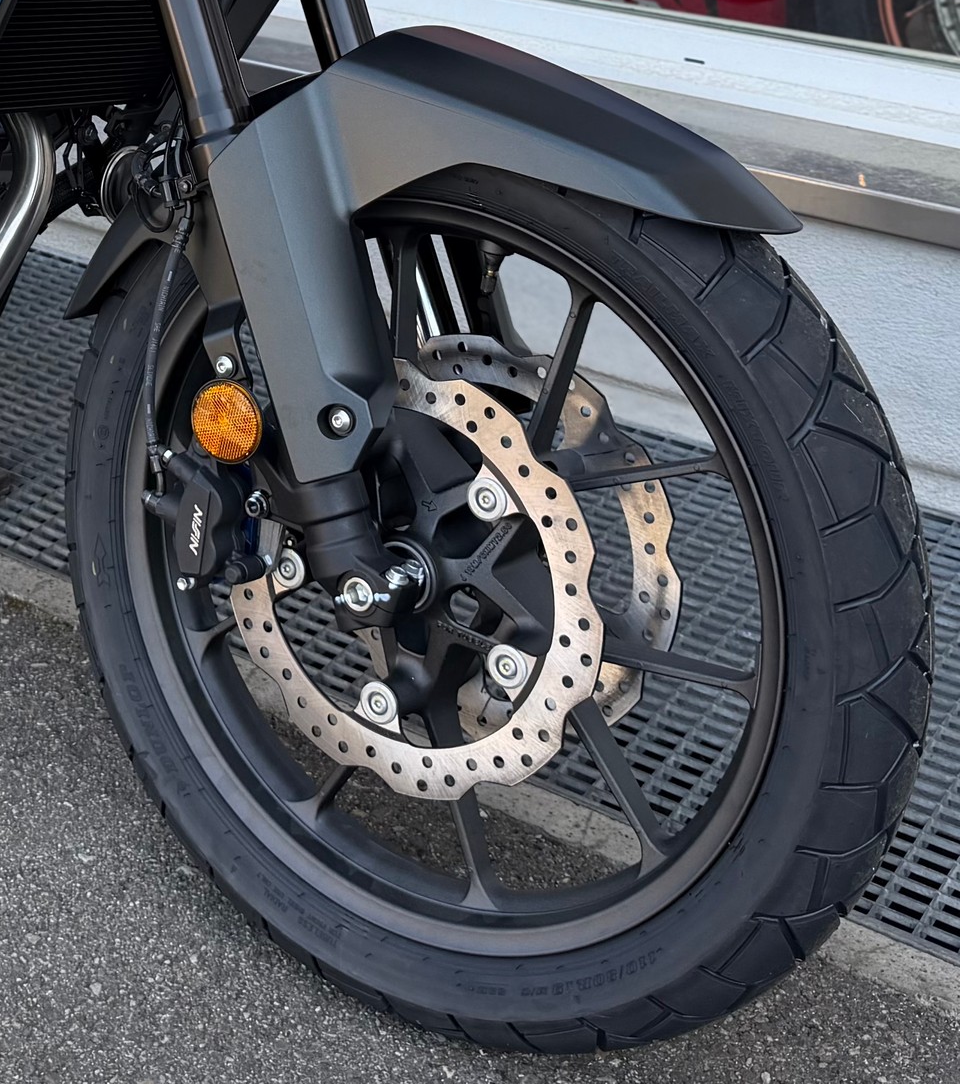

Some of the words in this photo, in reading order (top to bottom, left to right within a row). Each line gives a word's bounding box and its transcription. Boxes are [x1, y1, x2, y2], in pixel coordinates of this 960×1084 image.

[608, 248, 716, 360] TRAILMAX
[189, 504, 203, 556] NISSIN
[119, 664, 178, 774] DUNLOP
